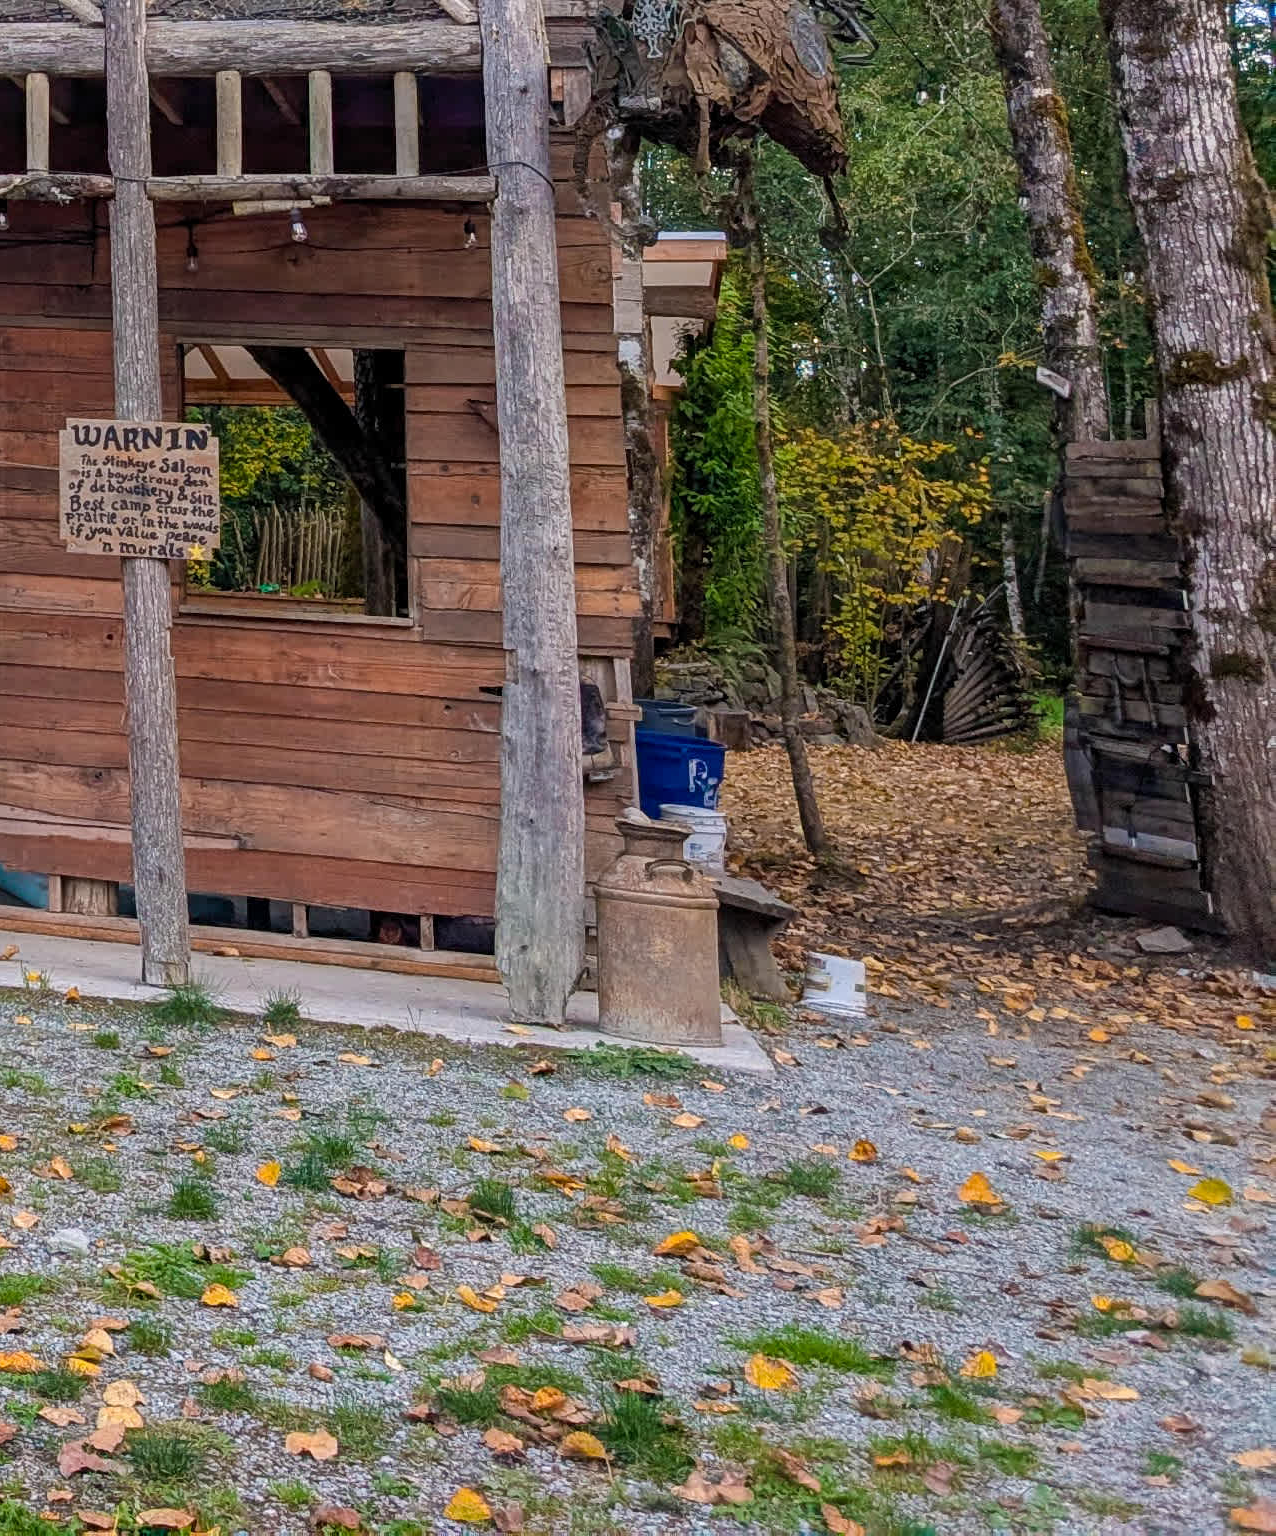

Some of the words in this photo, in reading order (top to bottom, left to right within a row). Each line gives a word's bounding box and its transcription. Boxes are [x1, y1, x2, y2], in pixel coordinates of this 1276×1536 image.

[80, 453, 98, 467] The
[158, 458, 214, 478] Saloon
[81, 466, 92, 479] is
[183, 474, 209, 488] den
[68, 479, 85, 494] of
[177, 485, 188, 502] &
[69, 495, 106, 513] Best
[111, 499, 152, 518] camp
[190, 506, 216, 519] the
[70, 522, 85, 538] if
[84, 525, 114, 542] you
[115, 525, 160, 541] value
[165, 531, 208, 546] peace
[122, 516, 138, 526] or
[141, 515, 156, 529] in
[157, 516, 180, 530] the
[182, 521, 220, 535] woods
[119, 541, 185, 558] morals
